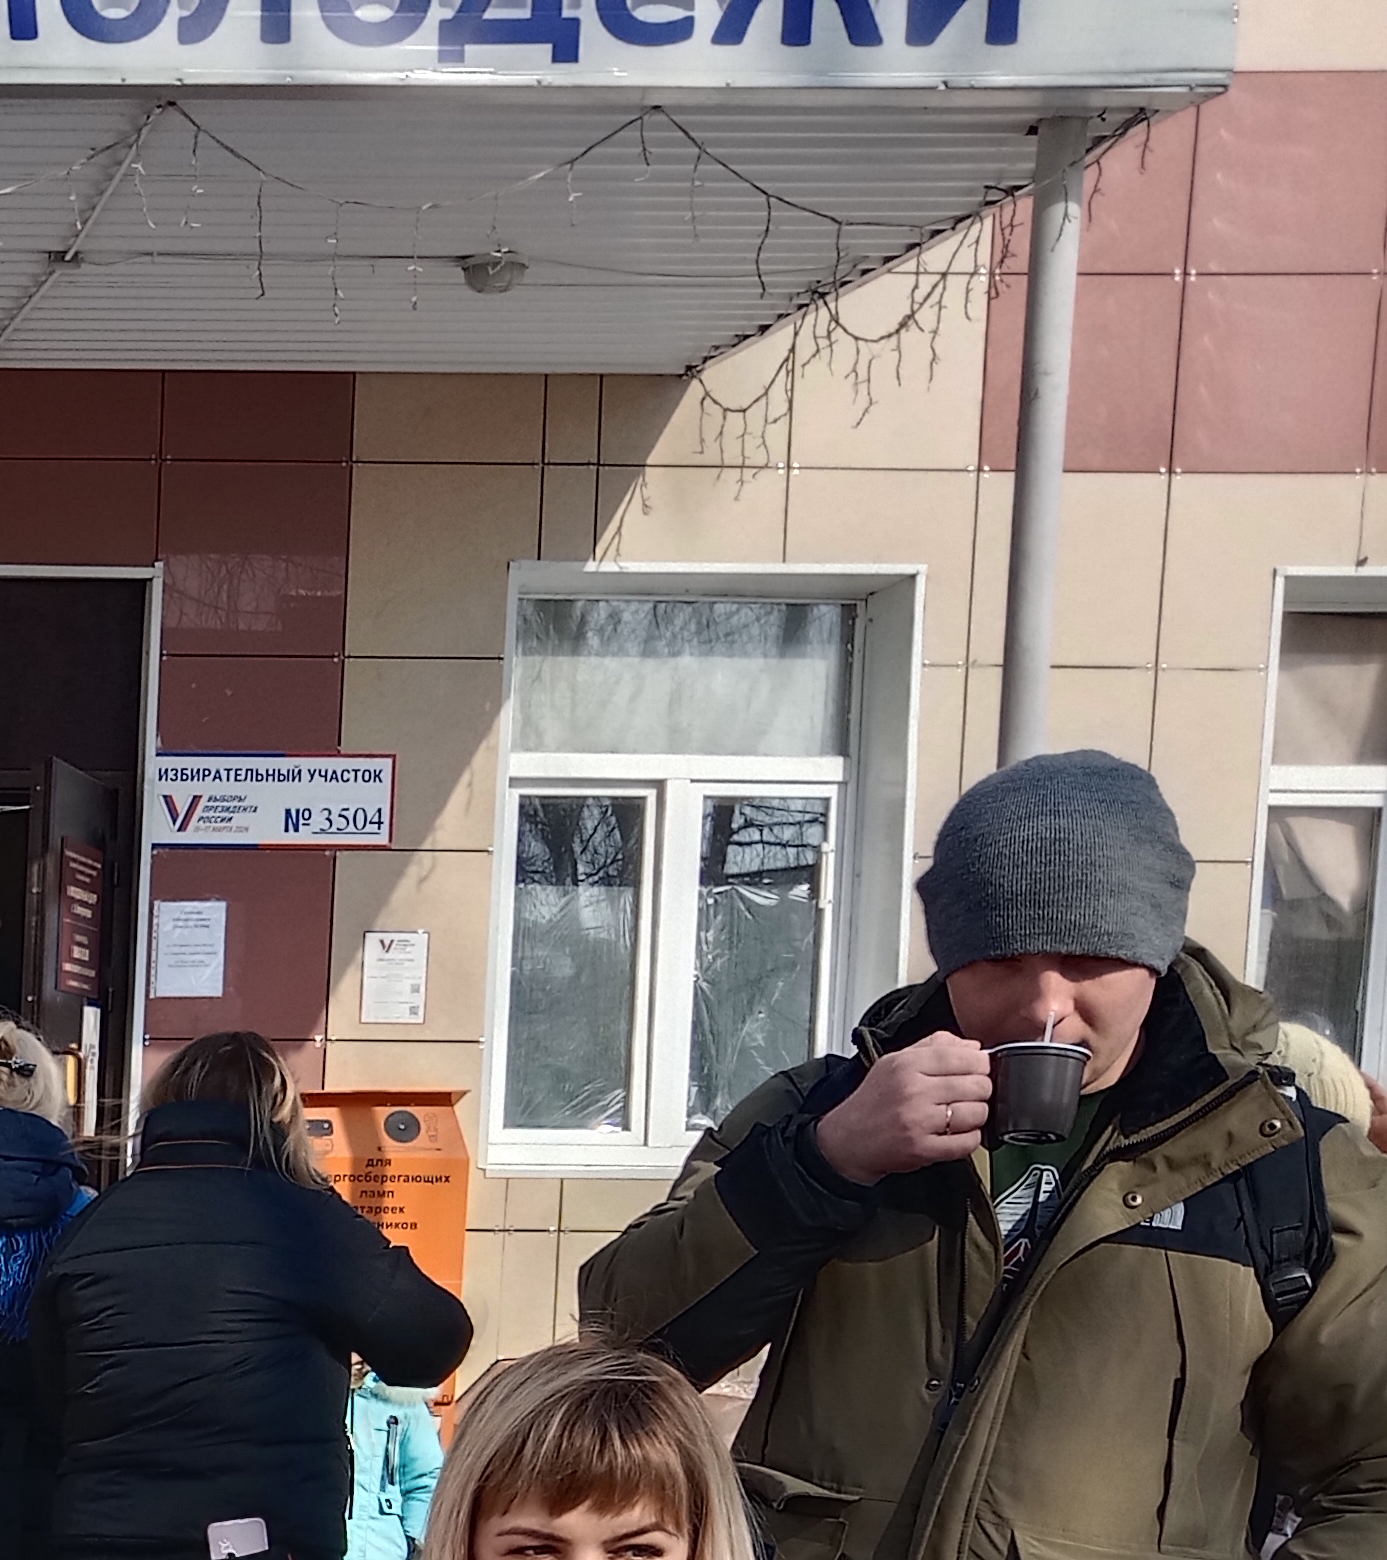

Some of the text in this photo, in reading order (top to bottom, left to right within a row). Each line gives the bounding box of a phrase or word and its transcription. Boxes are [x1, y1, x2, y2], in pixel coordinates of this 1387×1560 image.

[158, 765, 384, 784] ИЗБИРАТЕЛЬНЫЙ УЧАСТОК
[206, 794, 248, 803] ВЫБОРЫ
[201, 805, 259, 815] ПРЕЗИДЕНТА
[197, 815, 234, 824] РОССИИ
[319, 806, 385, 833] 3504
[365, 1158, 392, 1168] для
[328, 1171, 451, 1185] ргосберегающих
[359, 1189, 395, 1199] ламп
